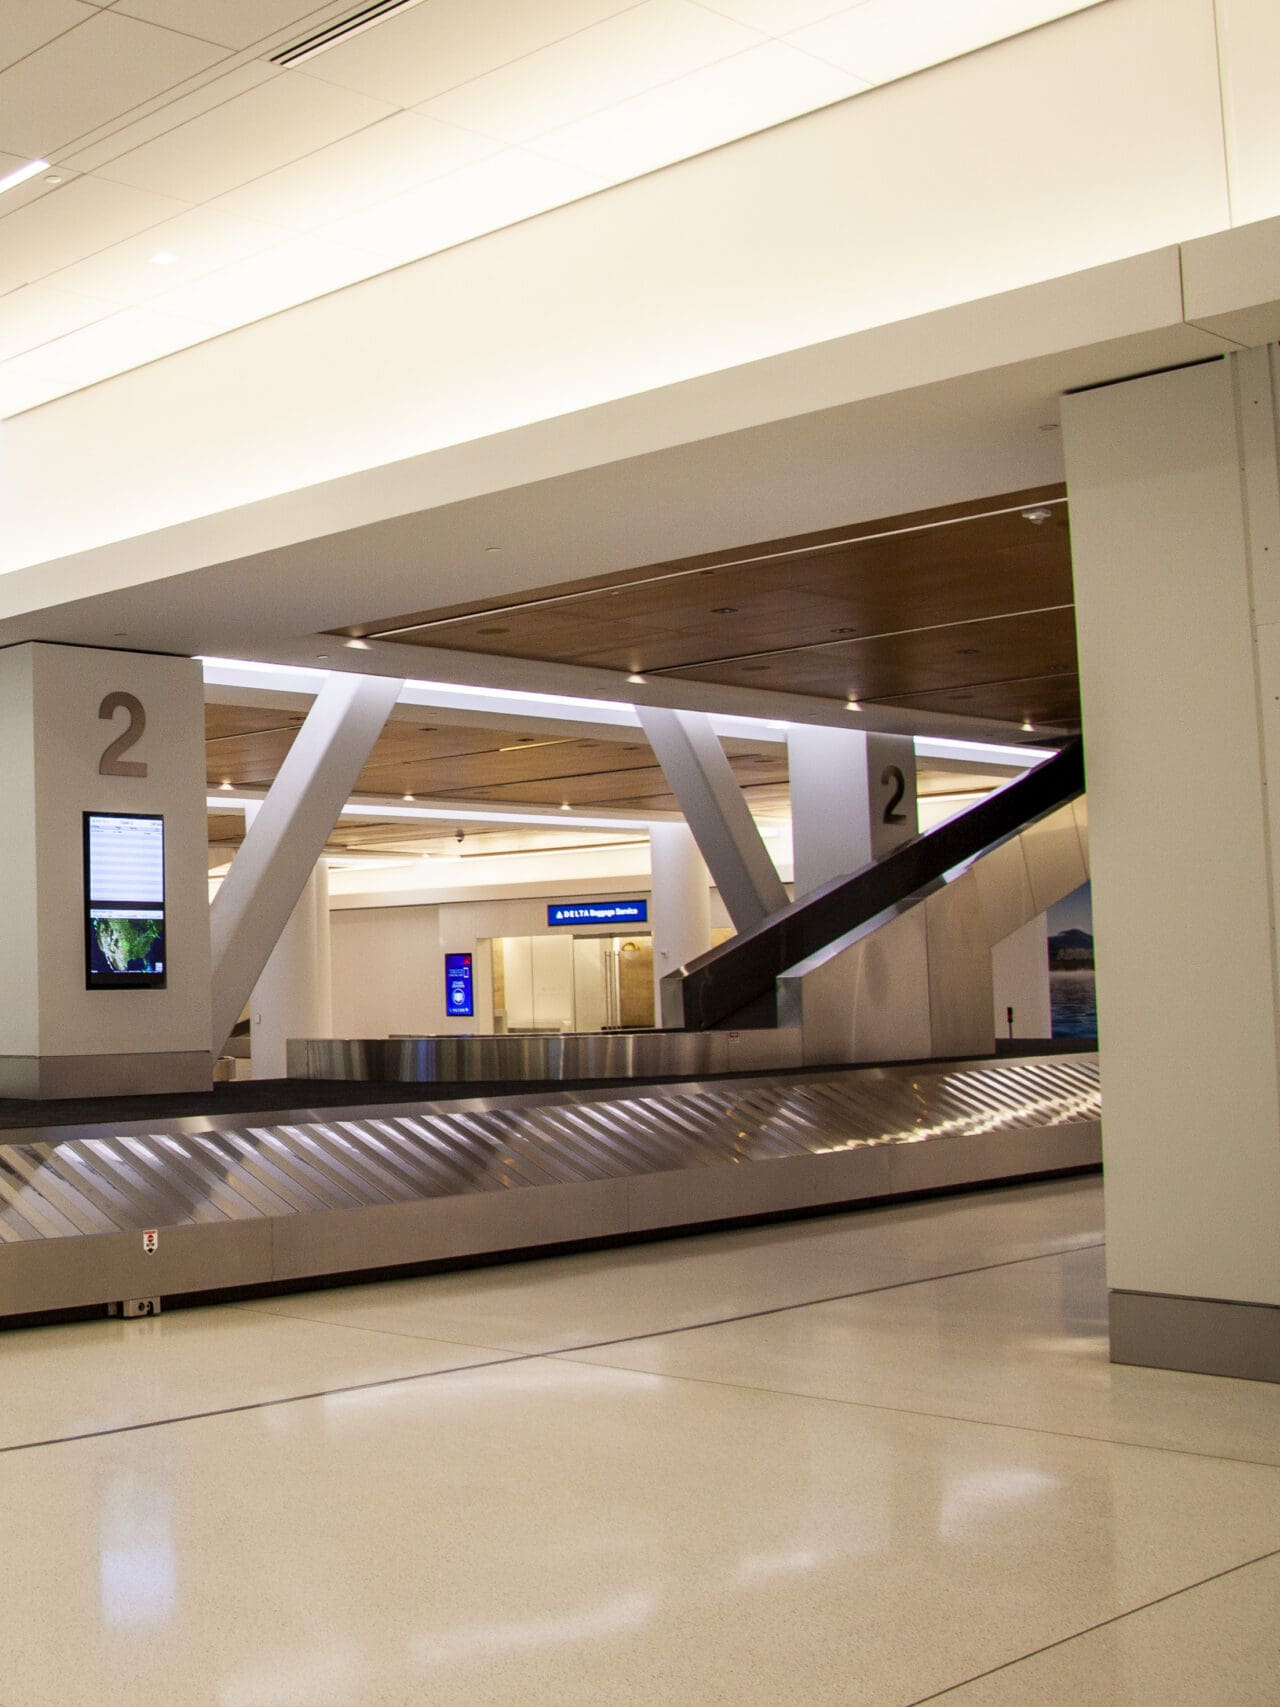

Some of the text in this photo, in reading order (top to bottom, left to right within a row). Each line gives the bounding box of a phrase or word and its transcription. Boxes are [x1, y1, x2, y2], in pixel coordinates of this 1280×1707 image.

[99, 691, 147, 777] 2
[881, 765, 907, 825] 2
[564, 910, 589, 918] DELTA
